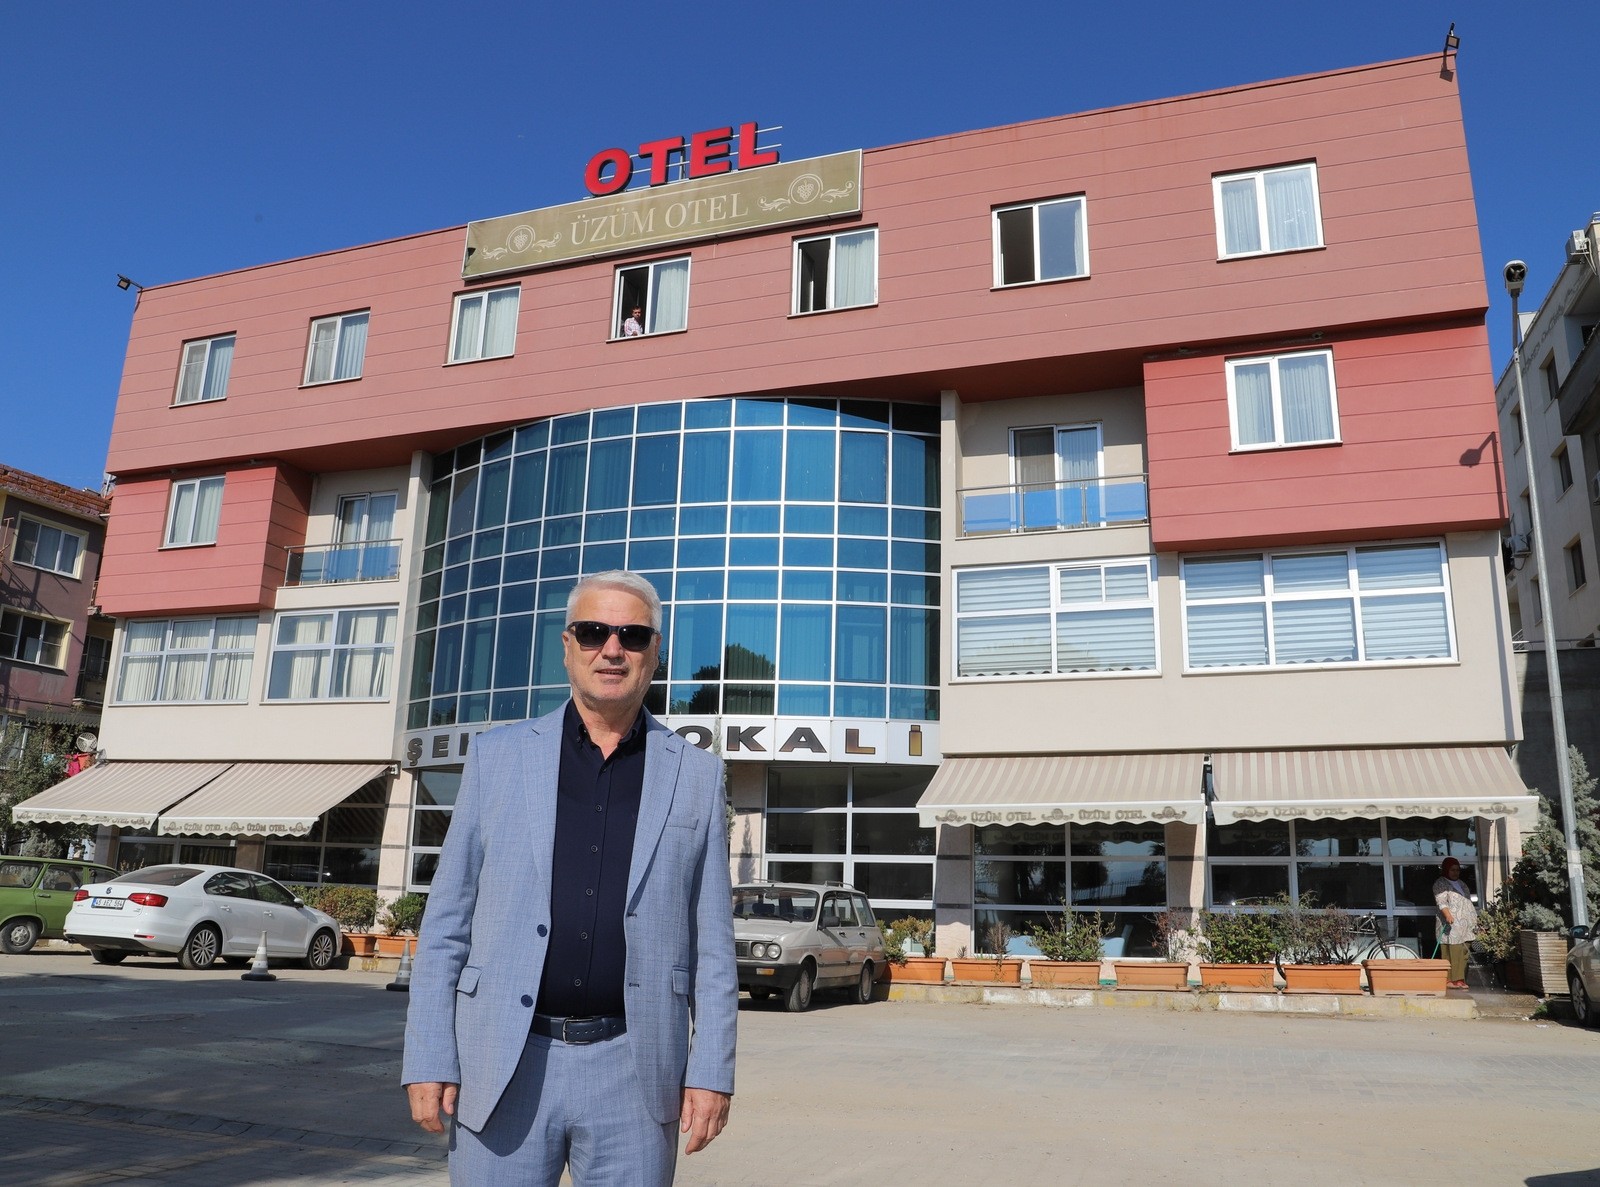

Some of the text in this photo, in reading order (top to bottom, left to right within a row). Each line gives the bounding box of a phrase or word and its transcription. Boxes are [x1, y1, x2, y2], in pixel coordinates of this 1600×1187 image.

[584, 121, 780, 197] OTEL
[570, 192, 749, 246] ÜZÜM OTEL
[674, 724, 923, 757] OKALİ
[184, 822, 288, 832] ÜZÜM OTEL ÜZÜM OTEL
[970, 809, 1147, 822] ÜZÜM OTEL ÜZÜM OTEL
